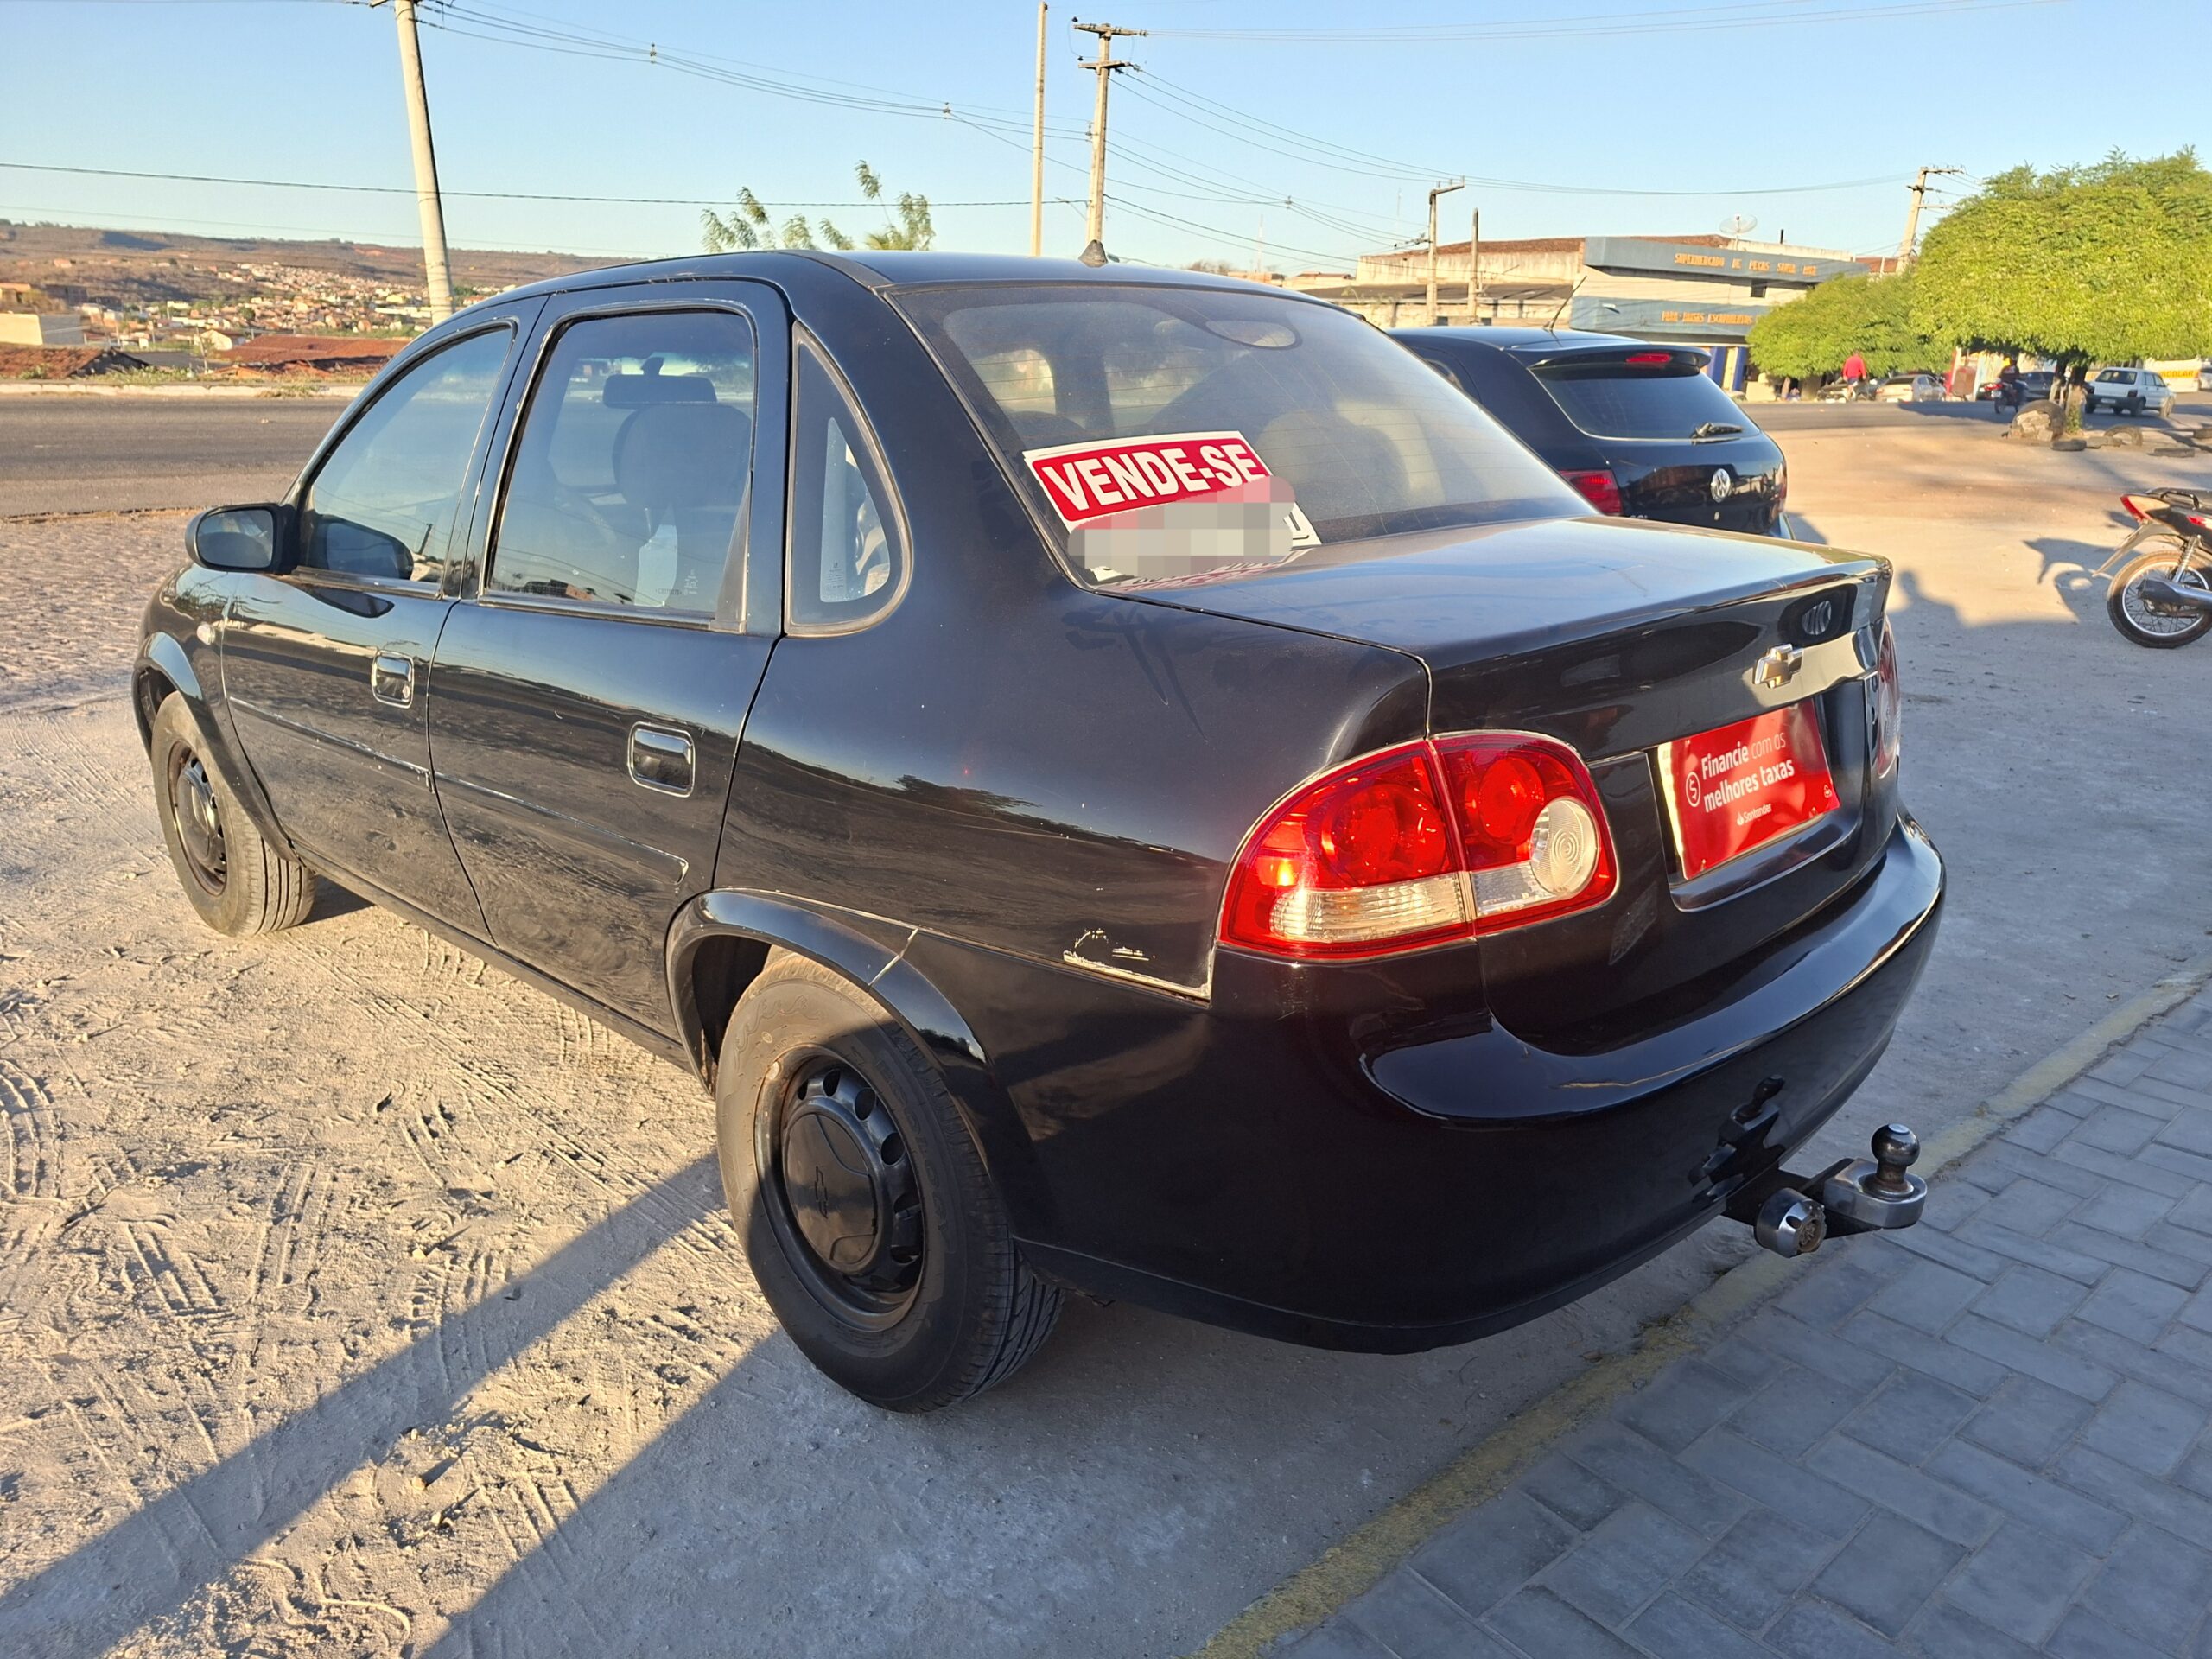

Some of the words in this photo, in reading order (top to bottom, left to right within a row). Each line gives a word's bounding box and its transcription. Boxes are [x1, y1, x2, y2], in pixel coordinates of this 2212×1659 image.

[1042, 444, 1266, 511] VENDE-SE
[1701, 741, 1749, 780] Financie
[1751, 738, 1773, 760] com
[1774, 732, 1786, 751] os
[1703, 773, 1759, 813] melhores
[1760, 759, 1795, 787] taxas
[1744, 803, 1772, 823] Santander
